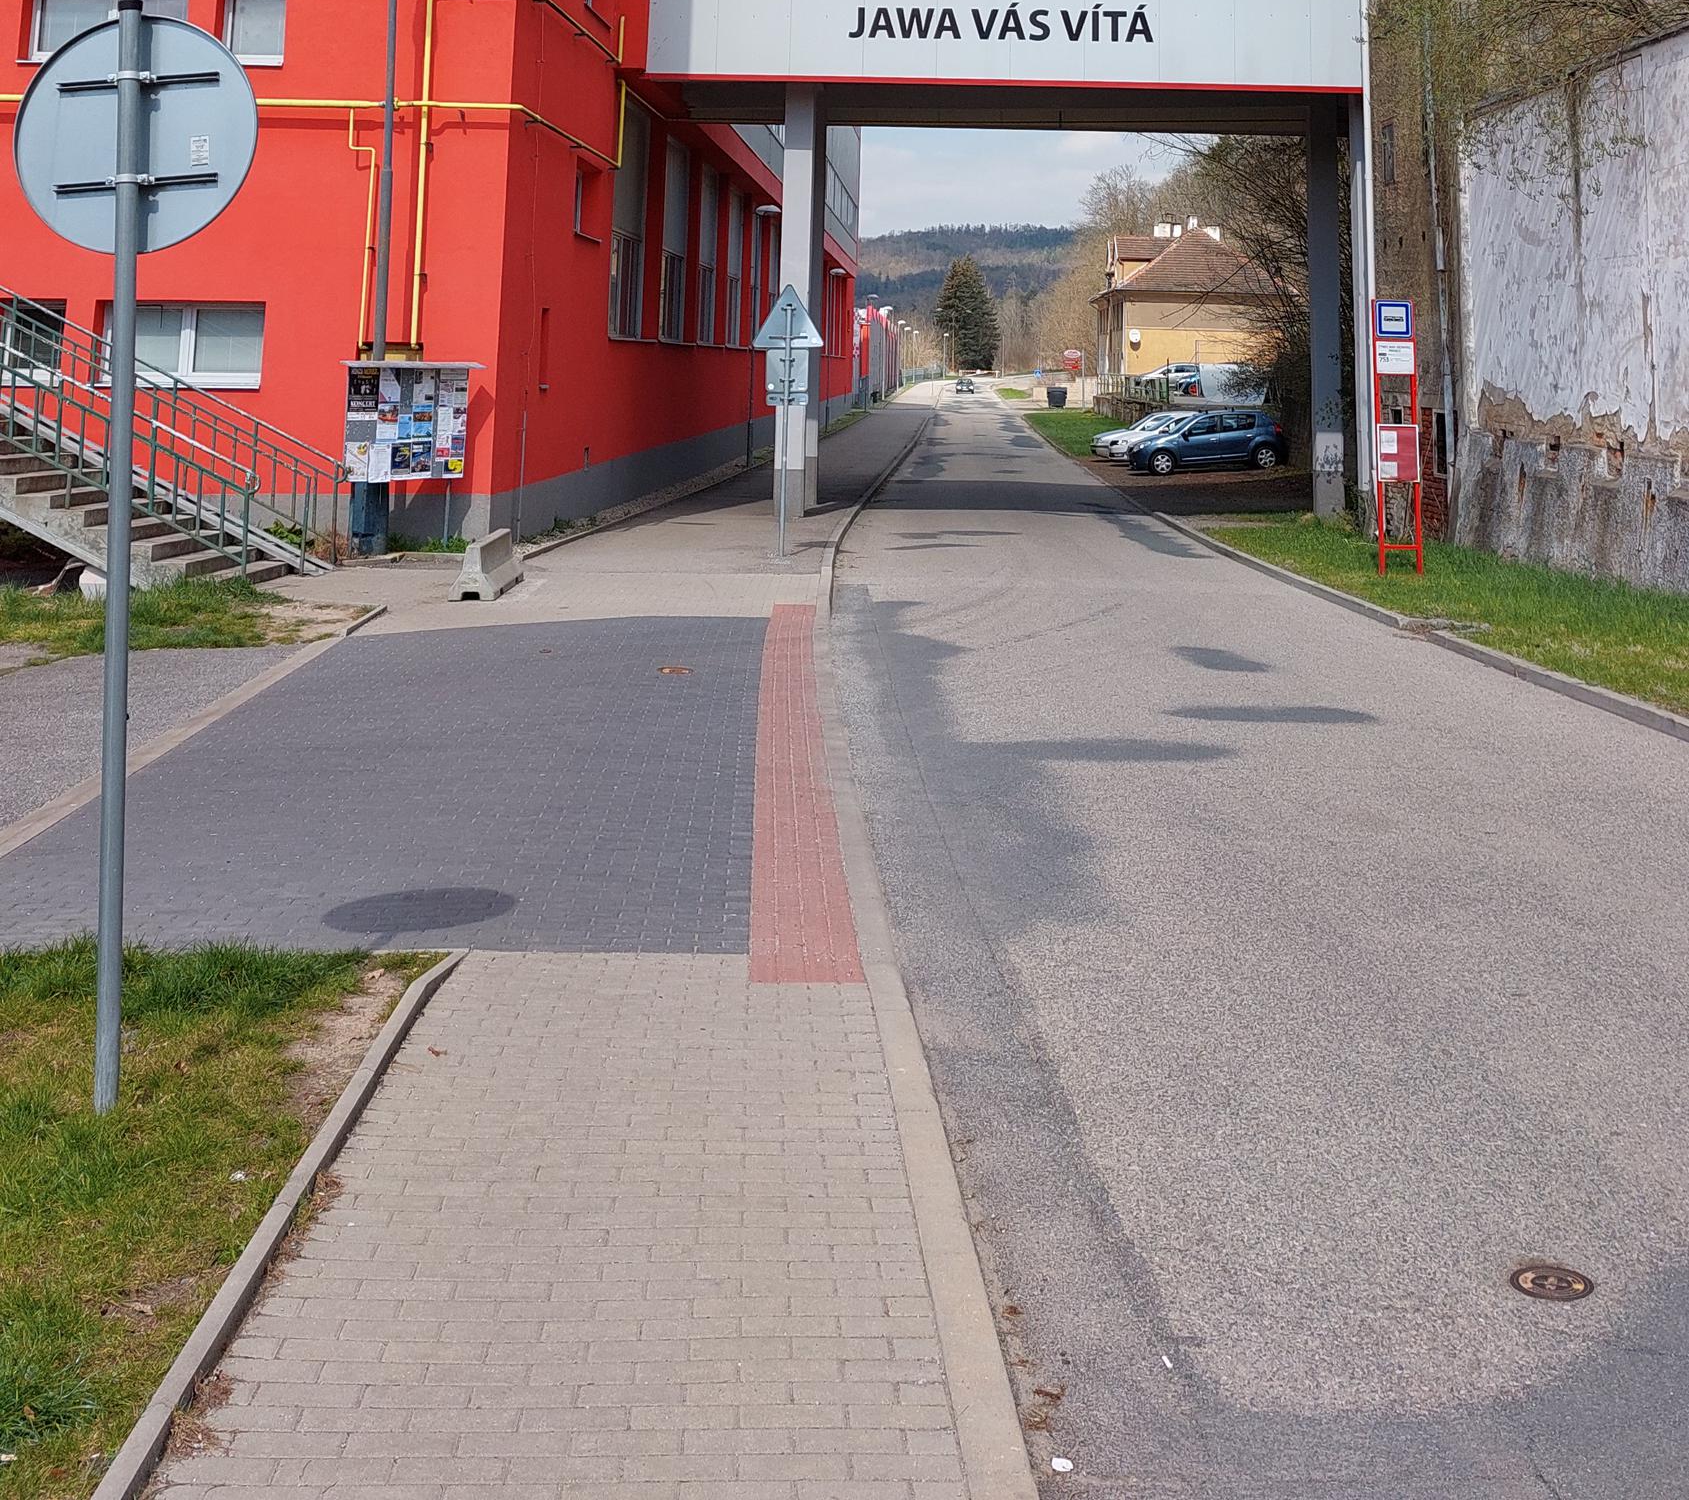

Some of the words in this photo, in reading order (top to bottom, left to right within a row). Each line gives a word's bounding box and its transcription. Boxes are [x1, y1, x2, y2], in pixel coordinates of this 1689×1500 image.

[848, 6, 961, 39] JAWA
[972, 2, 1051, 41] VÁS
[1060, 3, 1154, 43] VÍTÁ
[350, 400, 376, 408] KONCERT
